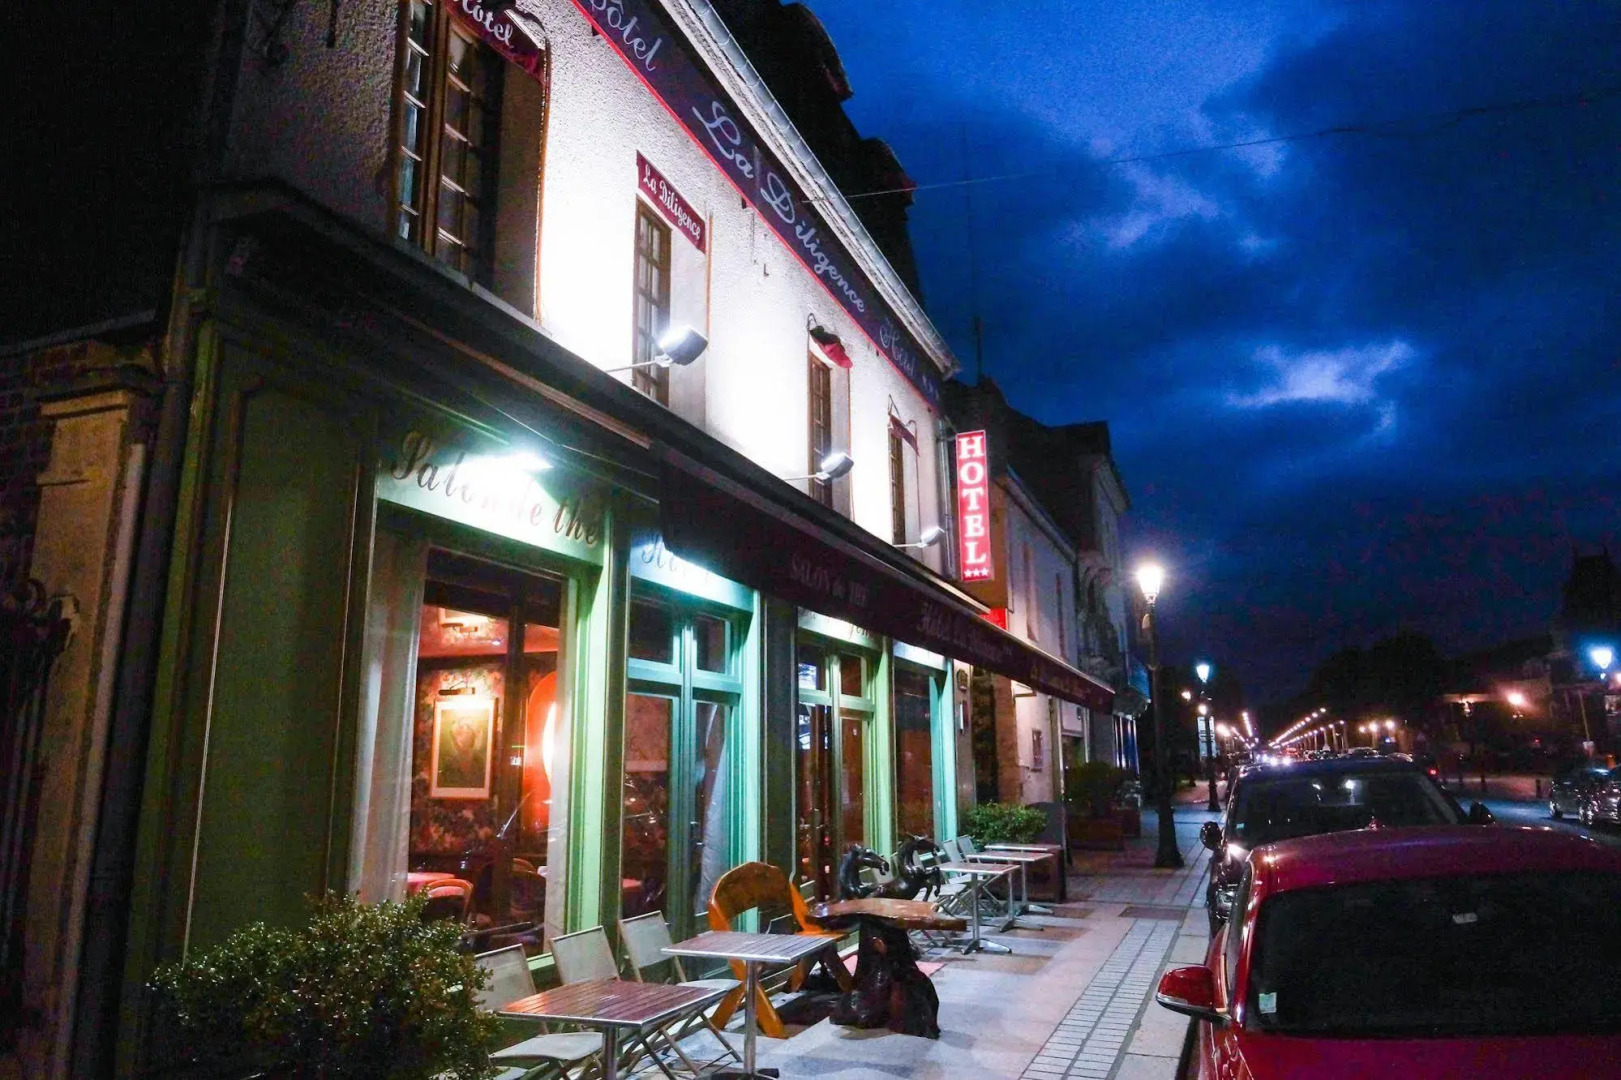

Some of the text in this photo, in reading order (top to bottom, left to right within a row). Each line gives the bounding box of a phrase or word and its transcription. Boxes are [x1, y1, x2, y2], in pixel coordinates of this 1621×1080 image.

[589, 0, 662, 71] ôtel
[692, 101, 754, 179] La
[760, 172, 865, 313] Diligence
[643, 164, 702, 241] La Diligence
[958, 435, 988, 565] HOTEL
